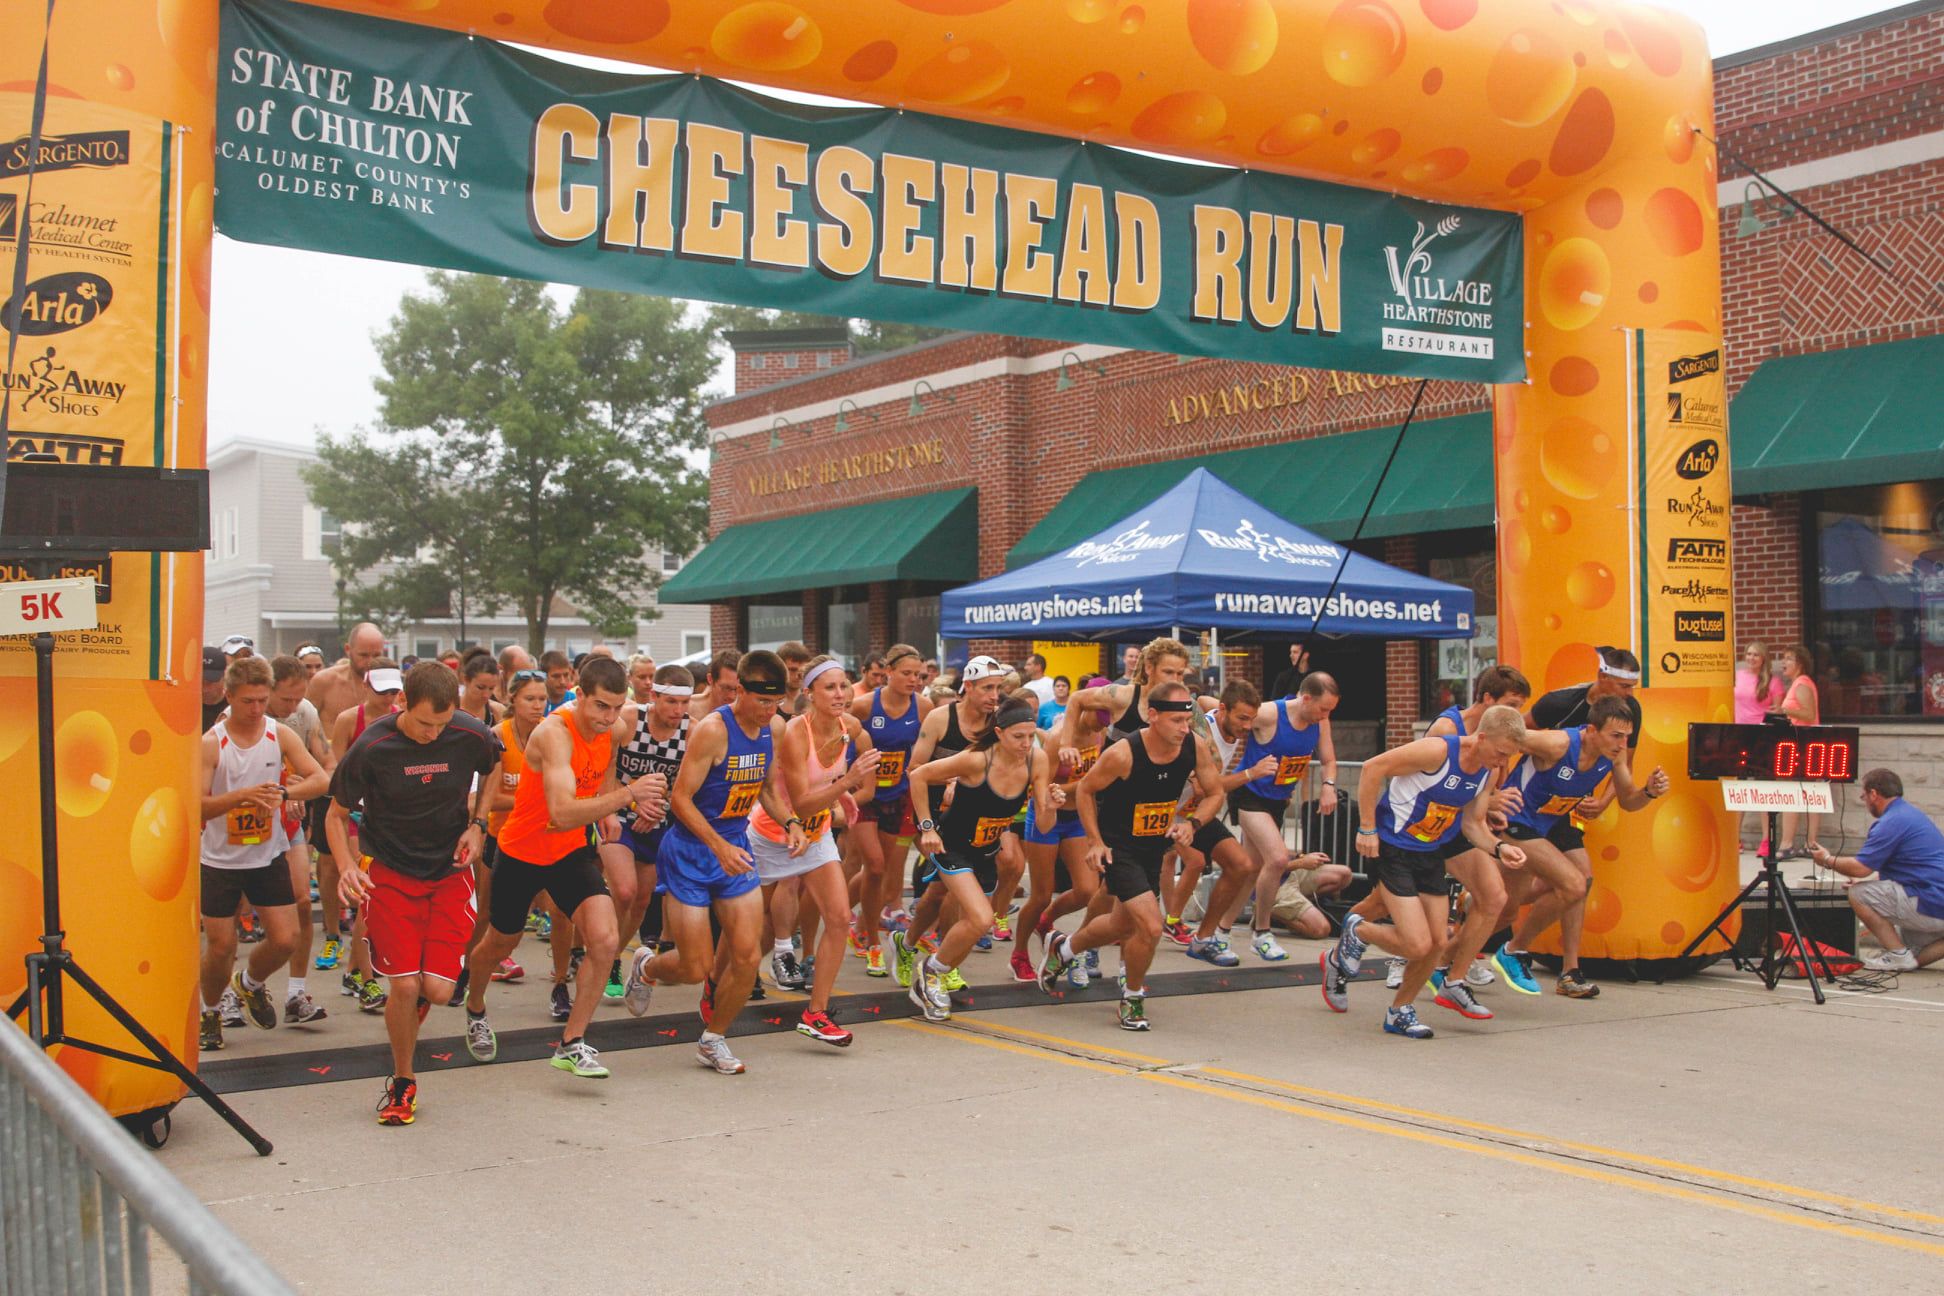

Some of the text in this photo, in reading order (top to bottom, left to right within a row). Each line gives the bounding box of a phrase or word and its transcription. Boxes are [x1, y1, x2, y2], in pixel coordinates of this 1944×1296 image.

[231, 47, 473, 126] STATE BANK
[235, 99, 461, 170] of CHILTON
[220, 141, 471, 199] CALUMET COUNTY'S
[258, 172, 435, 215] OLDEST BANK
[527, 102, 1344, 334] CHEESEHEAD RUN
[88, 232, 132, 252] Center
[45, 249, 90, 261] HEALTH
[93, 254, 132, 268] SYSTEM
[1384, 245, 1493, 306] VILLAGE
[22, 291, 84, 325] Arla
[1383, 303, 1493, 329] HEARTHSTONE
[1387, 334, 1489, 355] RESTAURANT
[1675, 356, 1718, 378] SARGENTO
[0, 370, 31, 390] UN
[1164, 374, 1310, 427] ADVANCED
[8, 437, 125, 466] AITH
[1683, 451, 1712, 473] Arla
[749, 438, 943, 496] VILLAGE HEARTHSTONE
[1668, 498, 1692, 512] RUN
[1667, 538, 1726, 562] FAITH
[21, 592, 63, 621] 5K
[964, 588, 1144, 625] runawayshoes.net
[1215, 592, 1442, 622] runawayshoes.net
[81, 634, 123, 645] BOARD
[82, 647, 130, 655] PRODUCERS
[404, 763, 449, 776] WISCONSIN
[739, 753, 759, 769] HALF
[1728, 787, 1748, 805] Half
[1750, 787, 1795, 805] Marathon
[1802, 789, 1827, 809] Relay
[1141, 813, 1169, 830] 129
